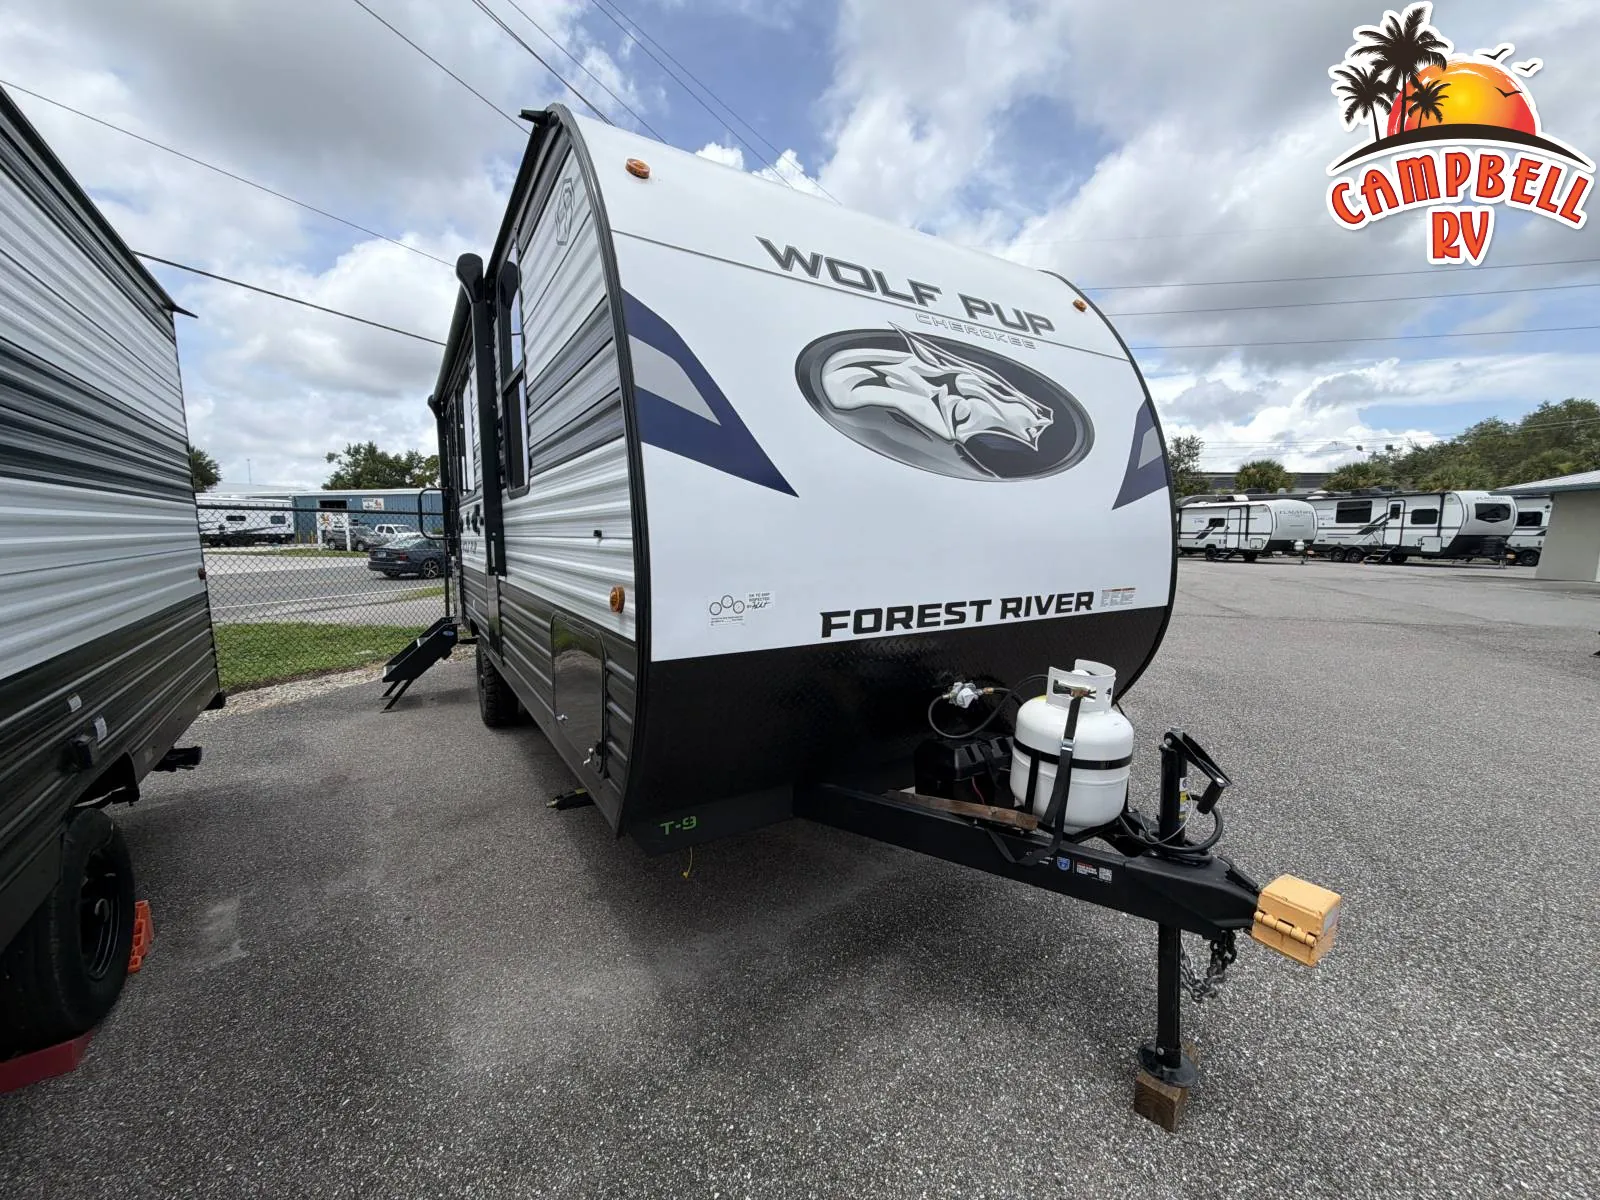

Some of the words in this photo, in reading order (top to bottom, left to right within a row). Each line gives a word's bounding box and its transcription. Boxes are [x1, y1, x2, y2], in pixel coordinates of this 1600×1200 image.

[755, 235, 943, 307] WOLF
[957, 292, 1056, 337] PUP
[914, 311, 1037, 350] CHEROKEE
[819, 598, 993, 639] FOREST
[999, 591, 1095, 620] RIVER
